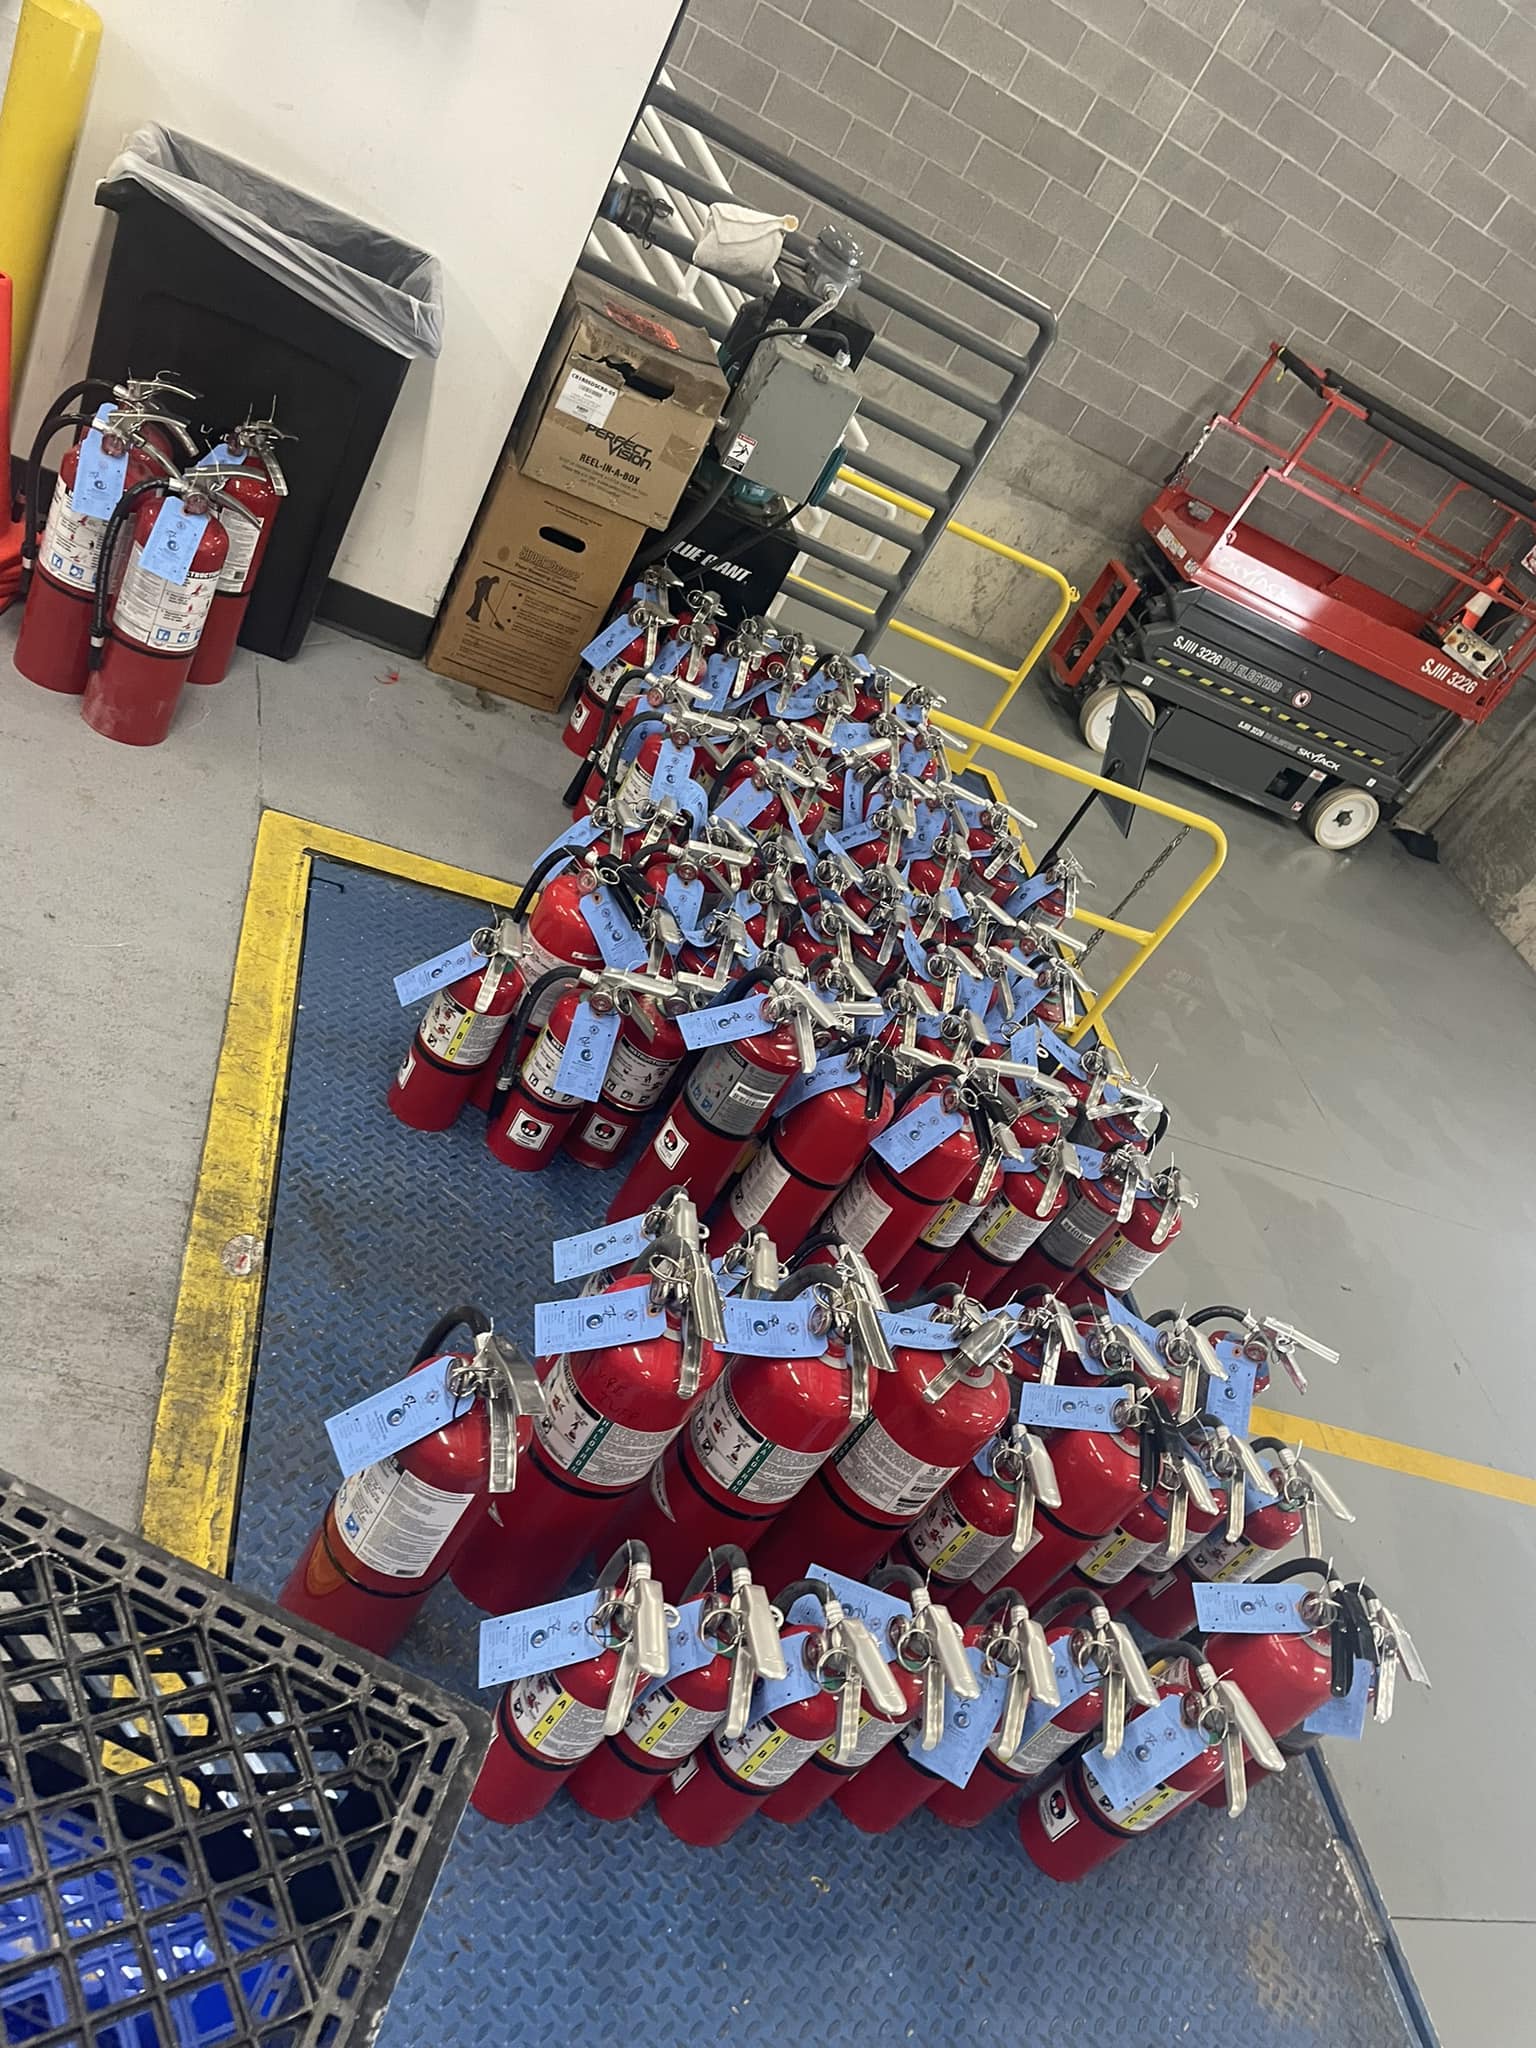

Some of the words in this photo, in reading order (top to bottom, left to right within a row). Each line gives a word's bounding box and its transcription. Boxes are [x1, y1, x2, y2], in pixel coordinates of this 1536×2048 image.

[585, 423, 653, 458] PERFECT
[609, 438, 653, 471] VISION
[579, 453, 641, 485] REEL-IN-A-BOX
[672, 541, 706, 562] LUE
[1196, 646, 1223, 666] 3226
[1233, 664, 1283, 694] ELECTRIC
[1446, 671, 1479, 694] 3226
[1297, 748, 1341, 771] SKYJACK
[732, 1442, 774, 1492] HALOTRON
[558, 1699, 567, 1709] A
[671, 1706, 680, 1716] A
[545, 1715, 554, 1724] B
[657, 1721, 667, 1730] B
[533, 1730, 542, 1740] C
[771, 1735, 781, 1744] A
[645, 1736, 654, 1745] C
[757, 1750, 767, 1759] B
[744, 1764, 753, 1773] C
